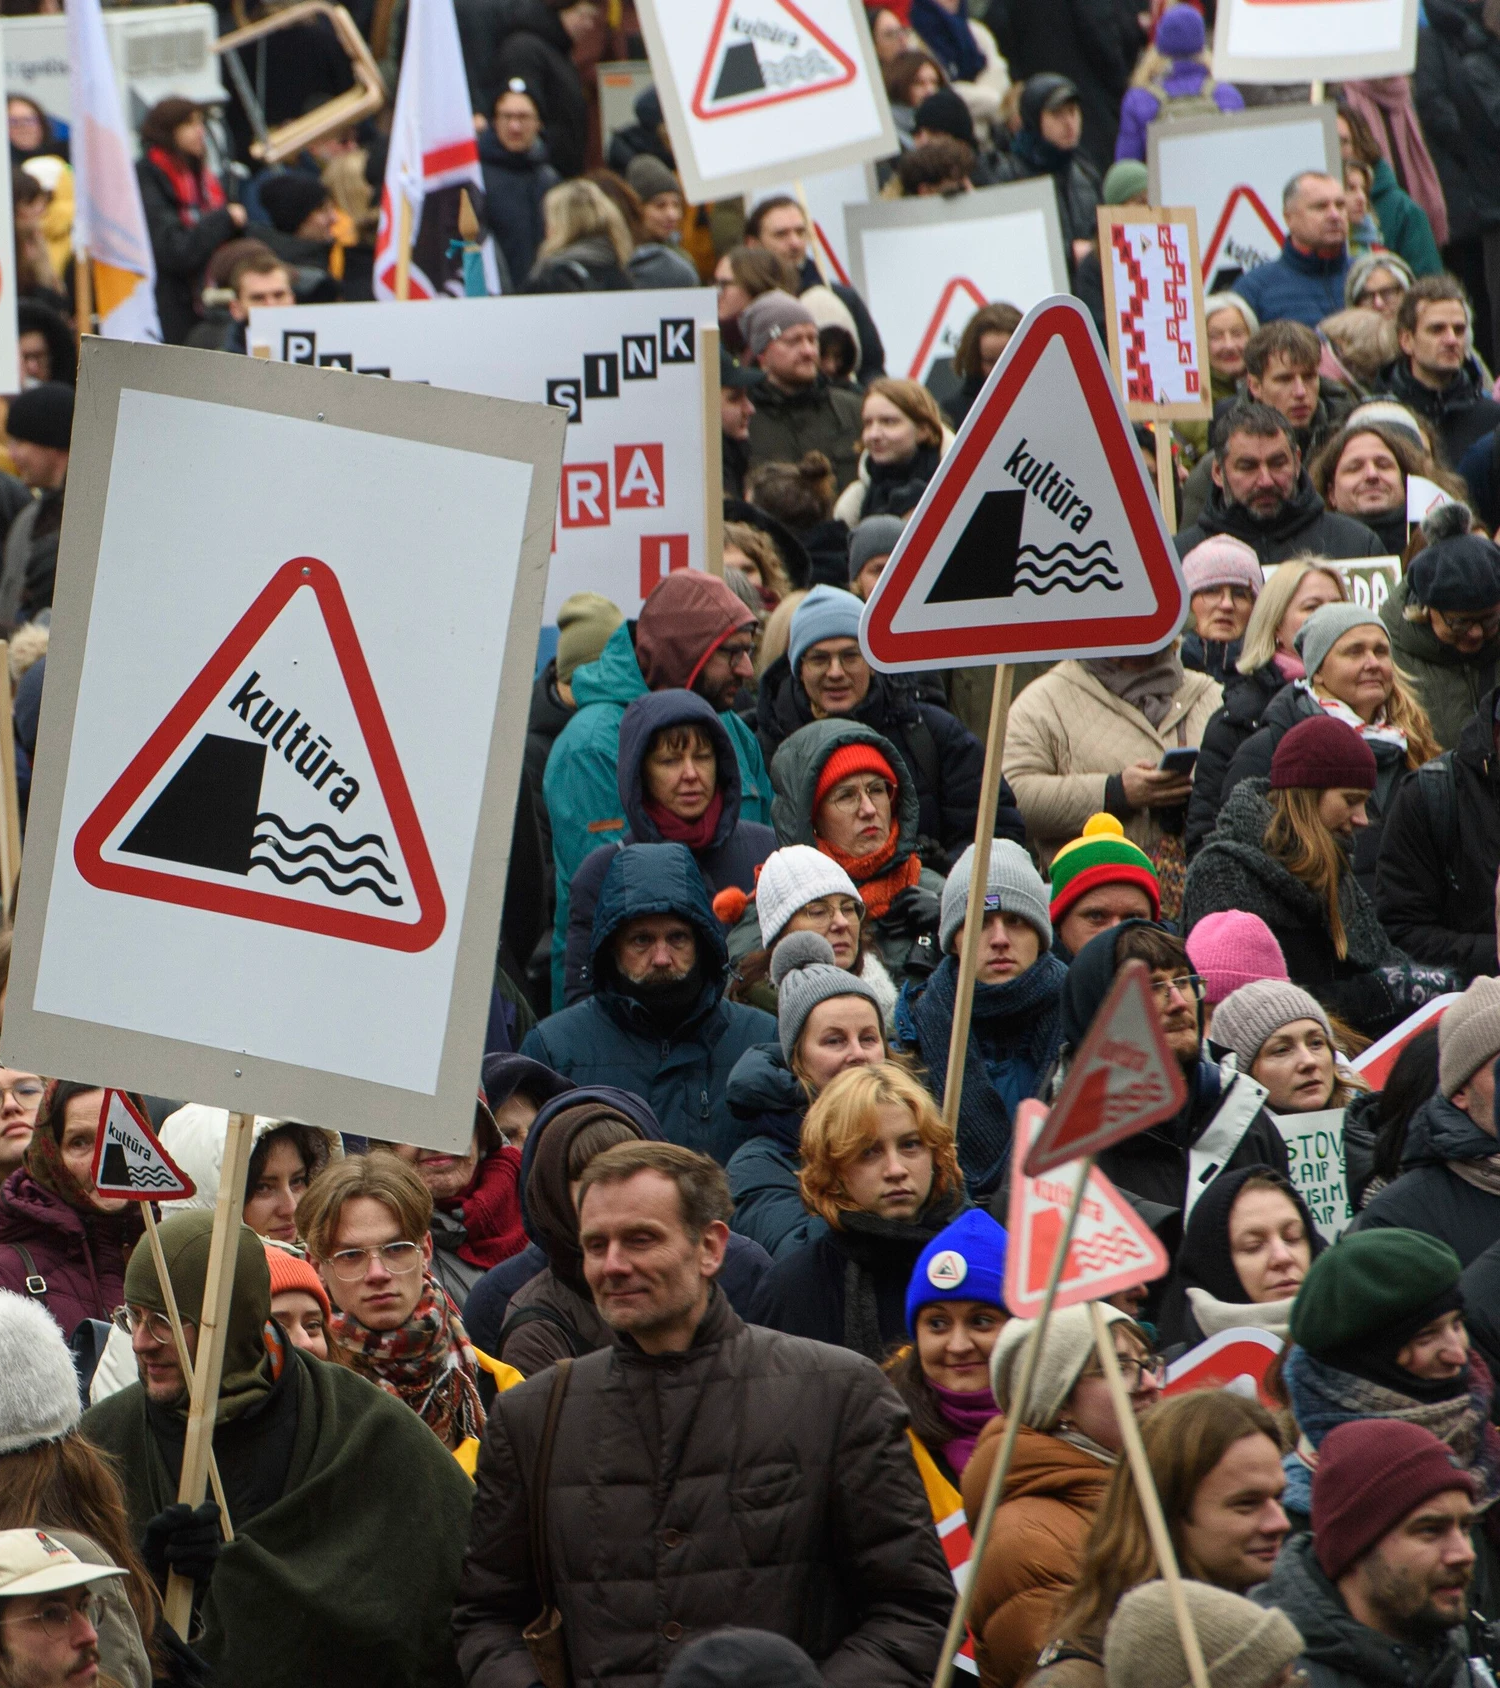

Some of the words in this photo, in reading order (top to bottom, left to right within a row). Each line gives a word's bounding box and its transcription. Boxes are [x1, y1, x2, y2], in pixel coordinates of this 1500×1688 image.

[1002, 437, 1093, 534] kultūra
[227, 670, 361, 815] kultūra
[108, 1121, 152, 1162] kultūra
